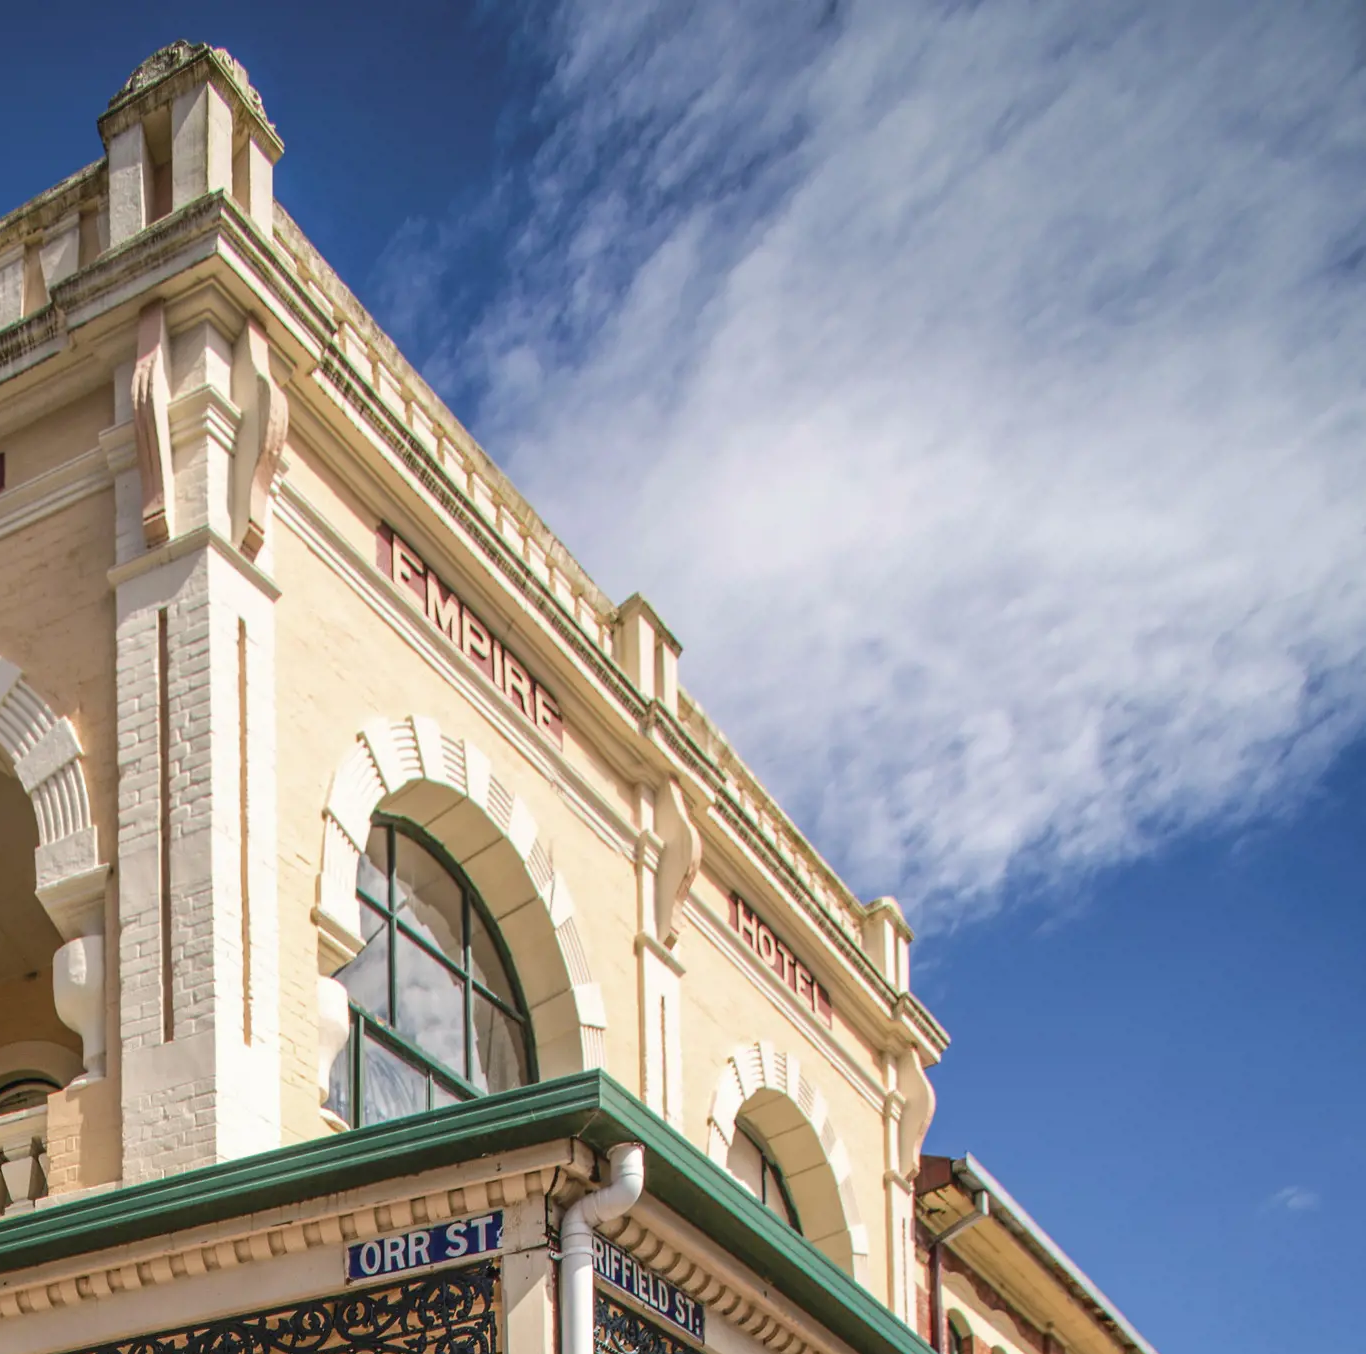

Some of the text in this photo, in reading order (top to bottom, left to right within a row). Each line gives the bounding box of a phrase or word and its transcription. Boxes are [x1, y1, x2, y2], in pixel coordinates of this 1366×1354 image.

[391, 532, 564, 753] EMPIRE
[737, 898, 832, 1031] HOTEL
[359, 1230, 431, 1276] ORR
